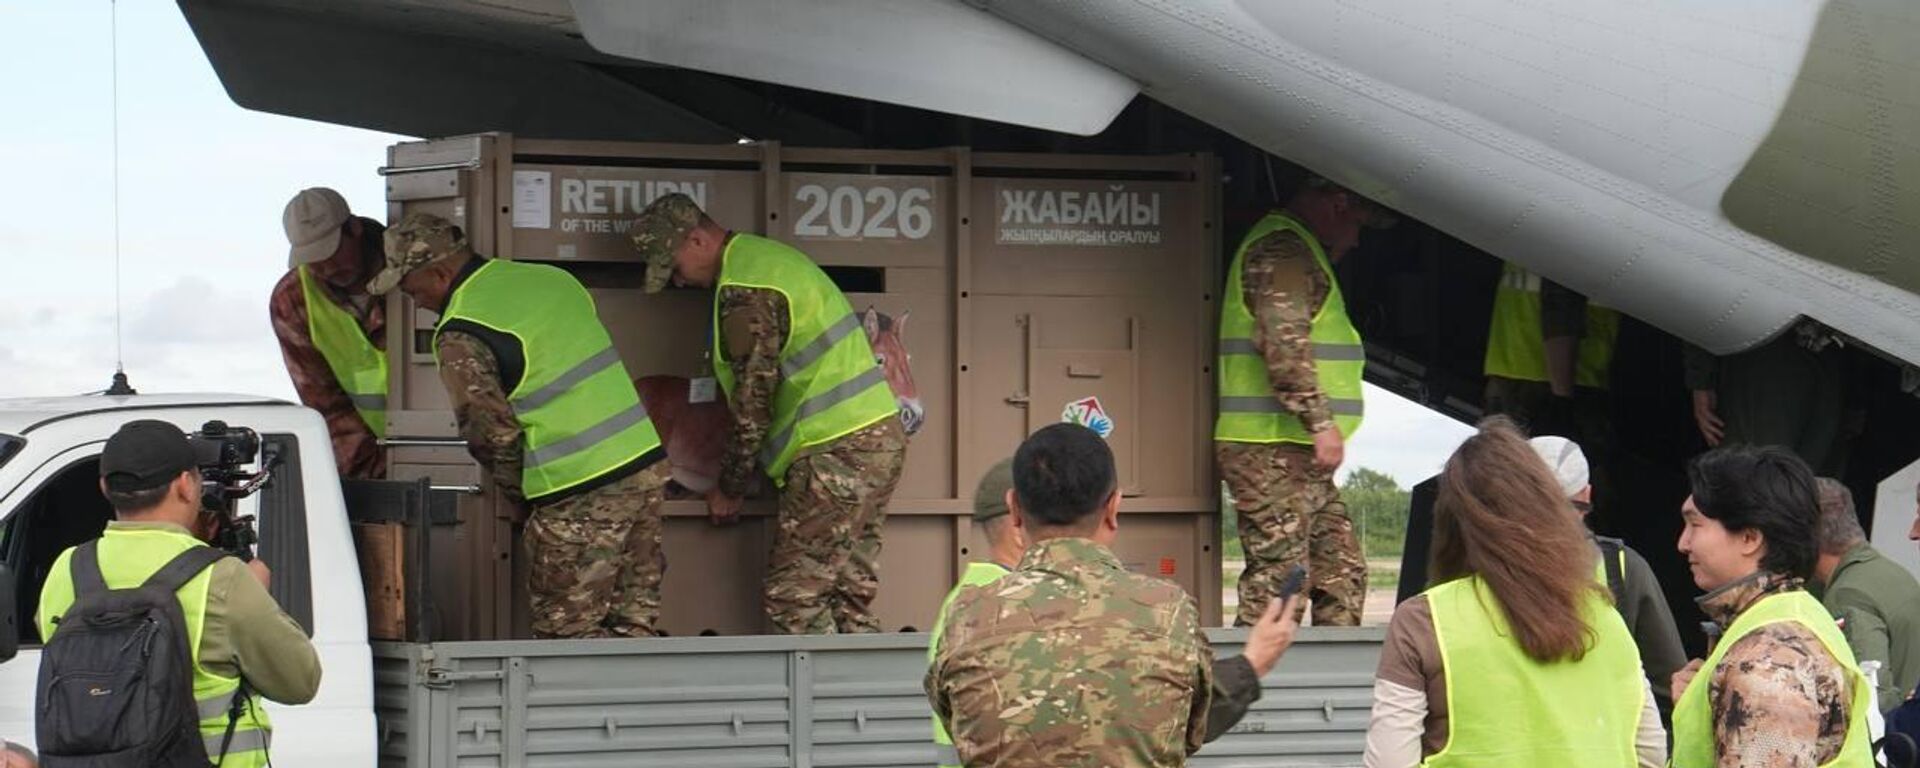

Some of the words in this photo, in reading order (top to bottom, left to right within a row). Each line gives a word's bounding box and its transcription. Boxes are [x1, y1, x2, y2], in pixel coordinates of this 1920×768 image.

[795, 185, 932, 239] 2026
[1001, 185, 1160, 225] ЖАБАЙЫ
[561, 219, 578, 232] OF
[584, 219, 611, 233] THE
[1110, 230, 1160, 244] ОРАЛУЫ
